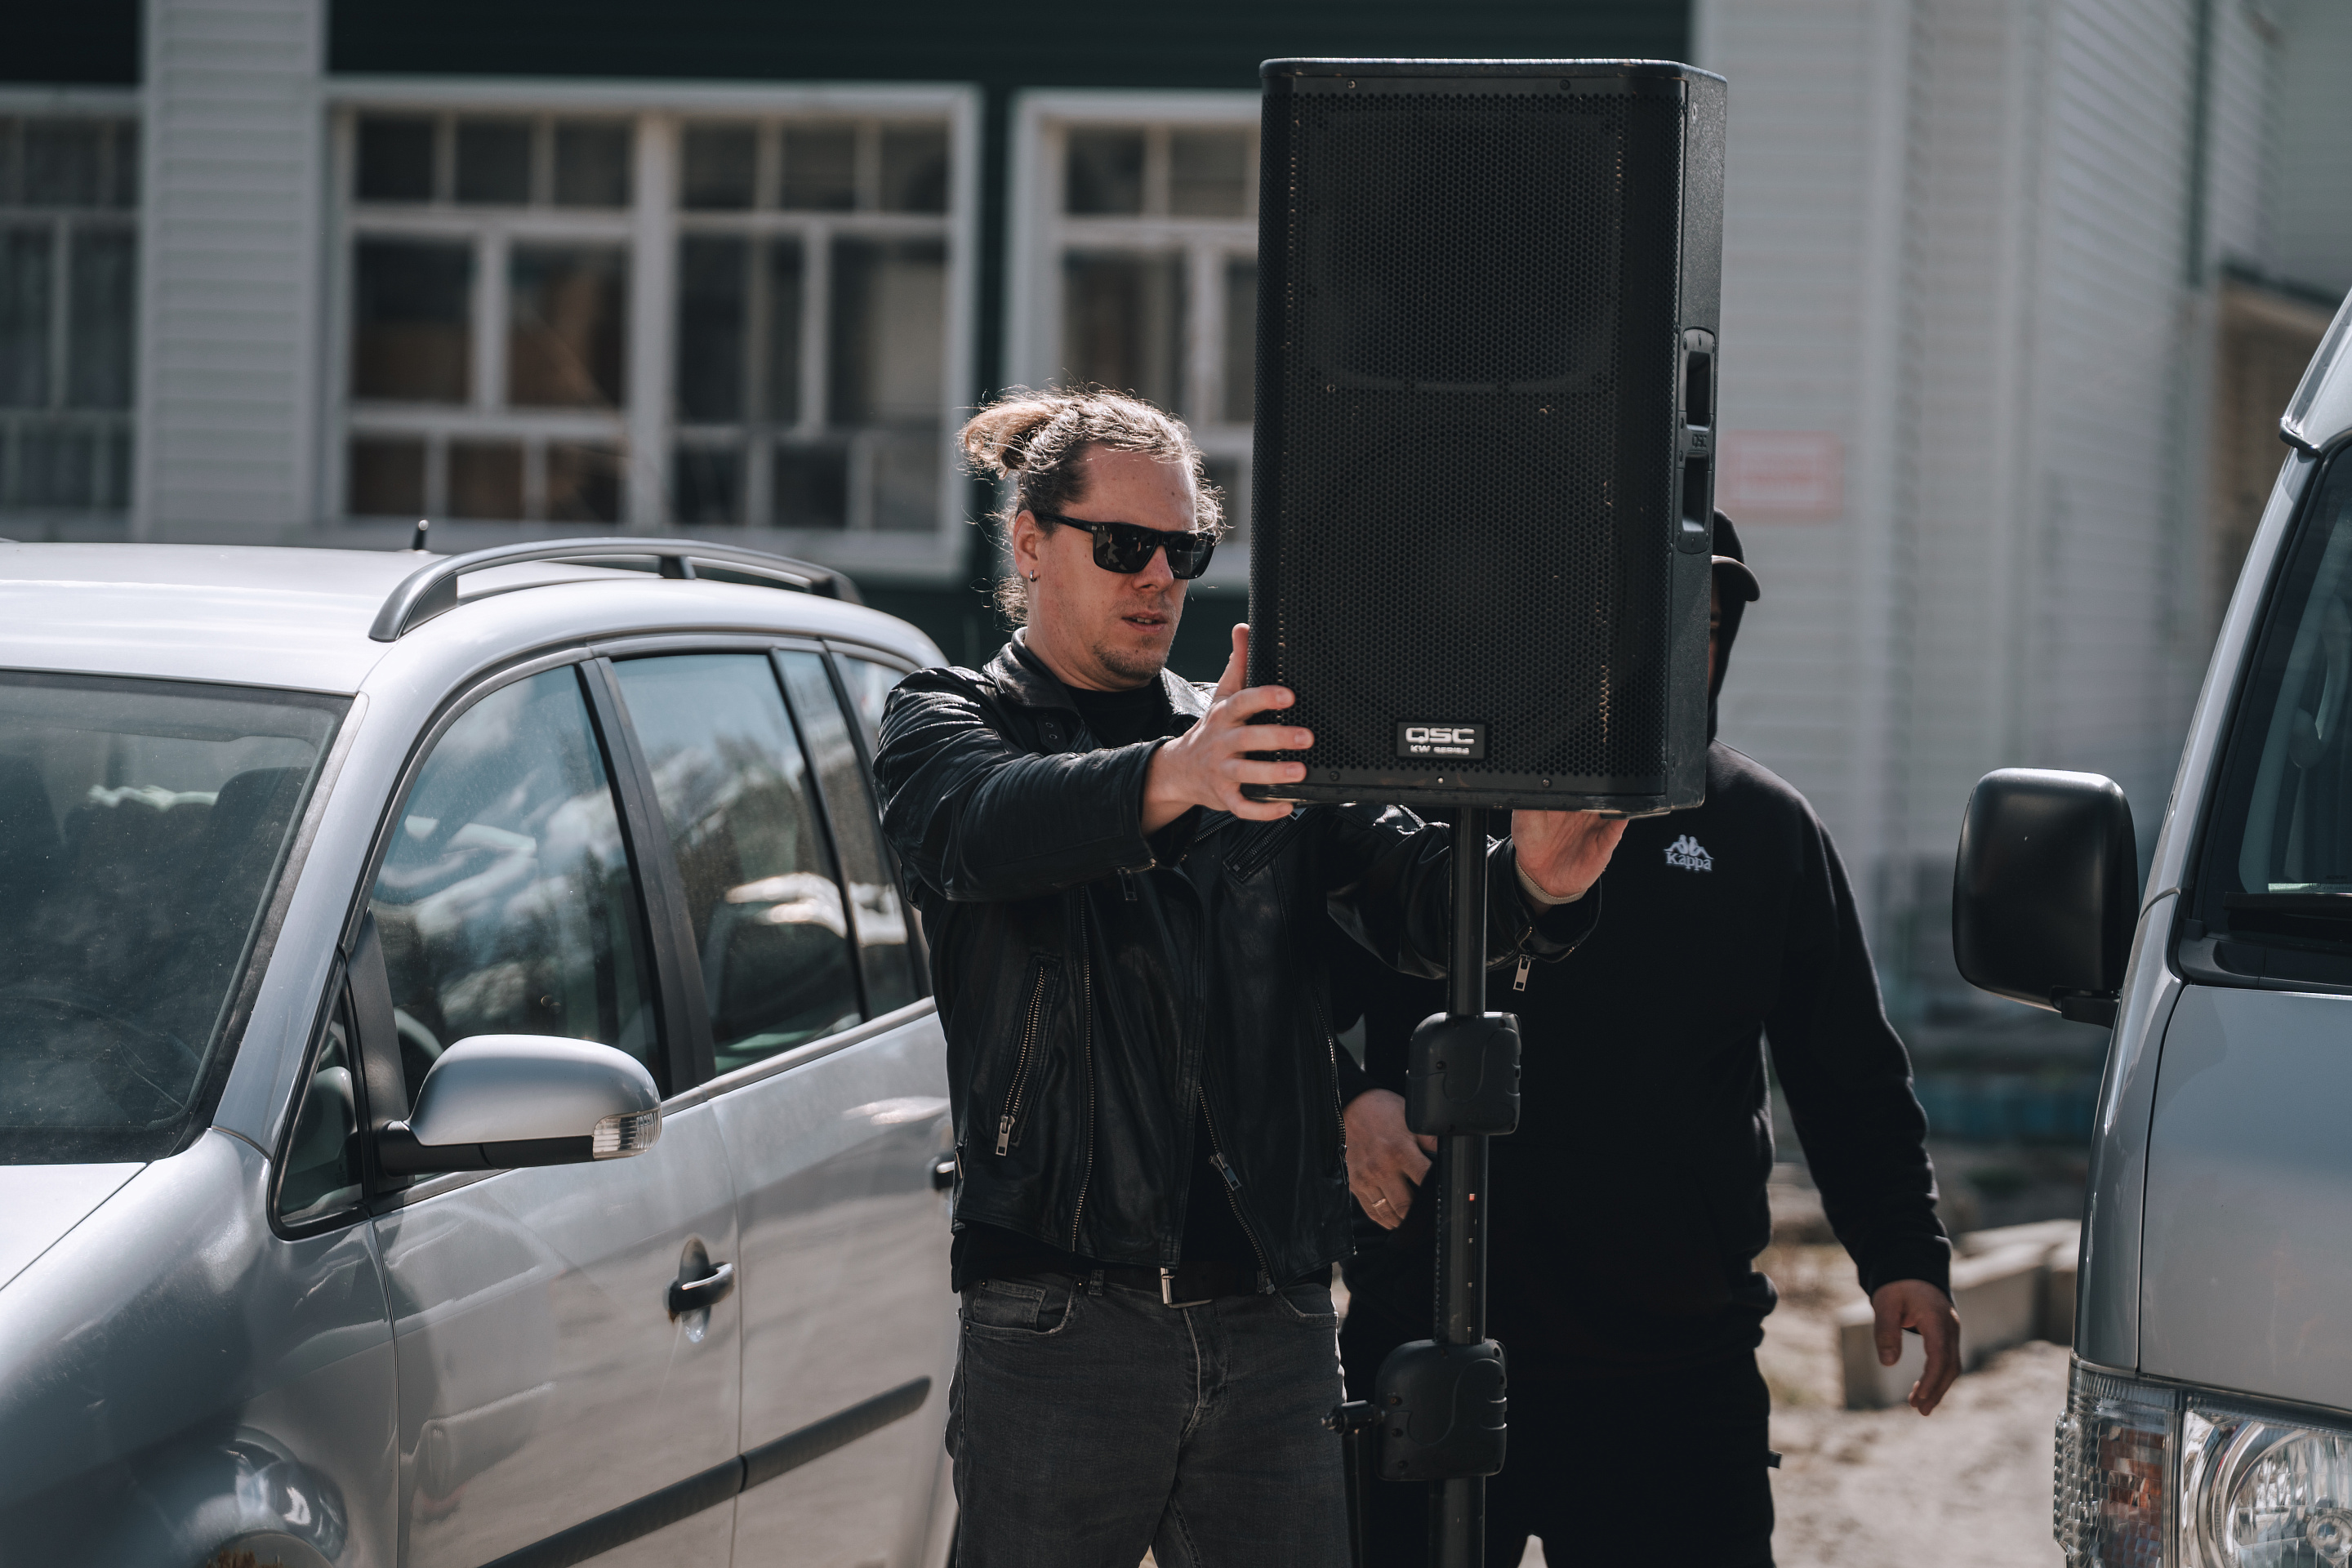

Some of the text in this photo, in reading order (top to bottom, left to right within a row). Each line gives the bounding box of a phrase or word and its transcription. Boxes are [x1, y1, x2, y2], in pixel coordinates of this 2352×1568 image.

[1405, 727, 1475, 745] QSC
[1410, 744, 1431, 753] KW
[1665, 852, 1713, 871] Kappa
